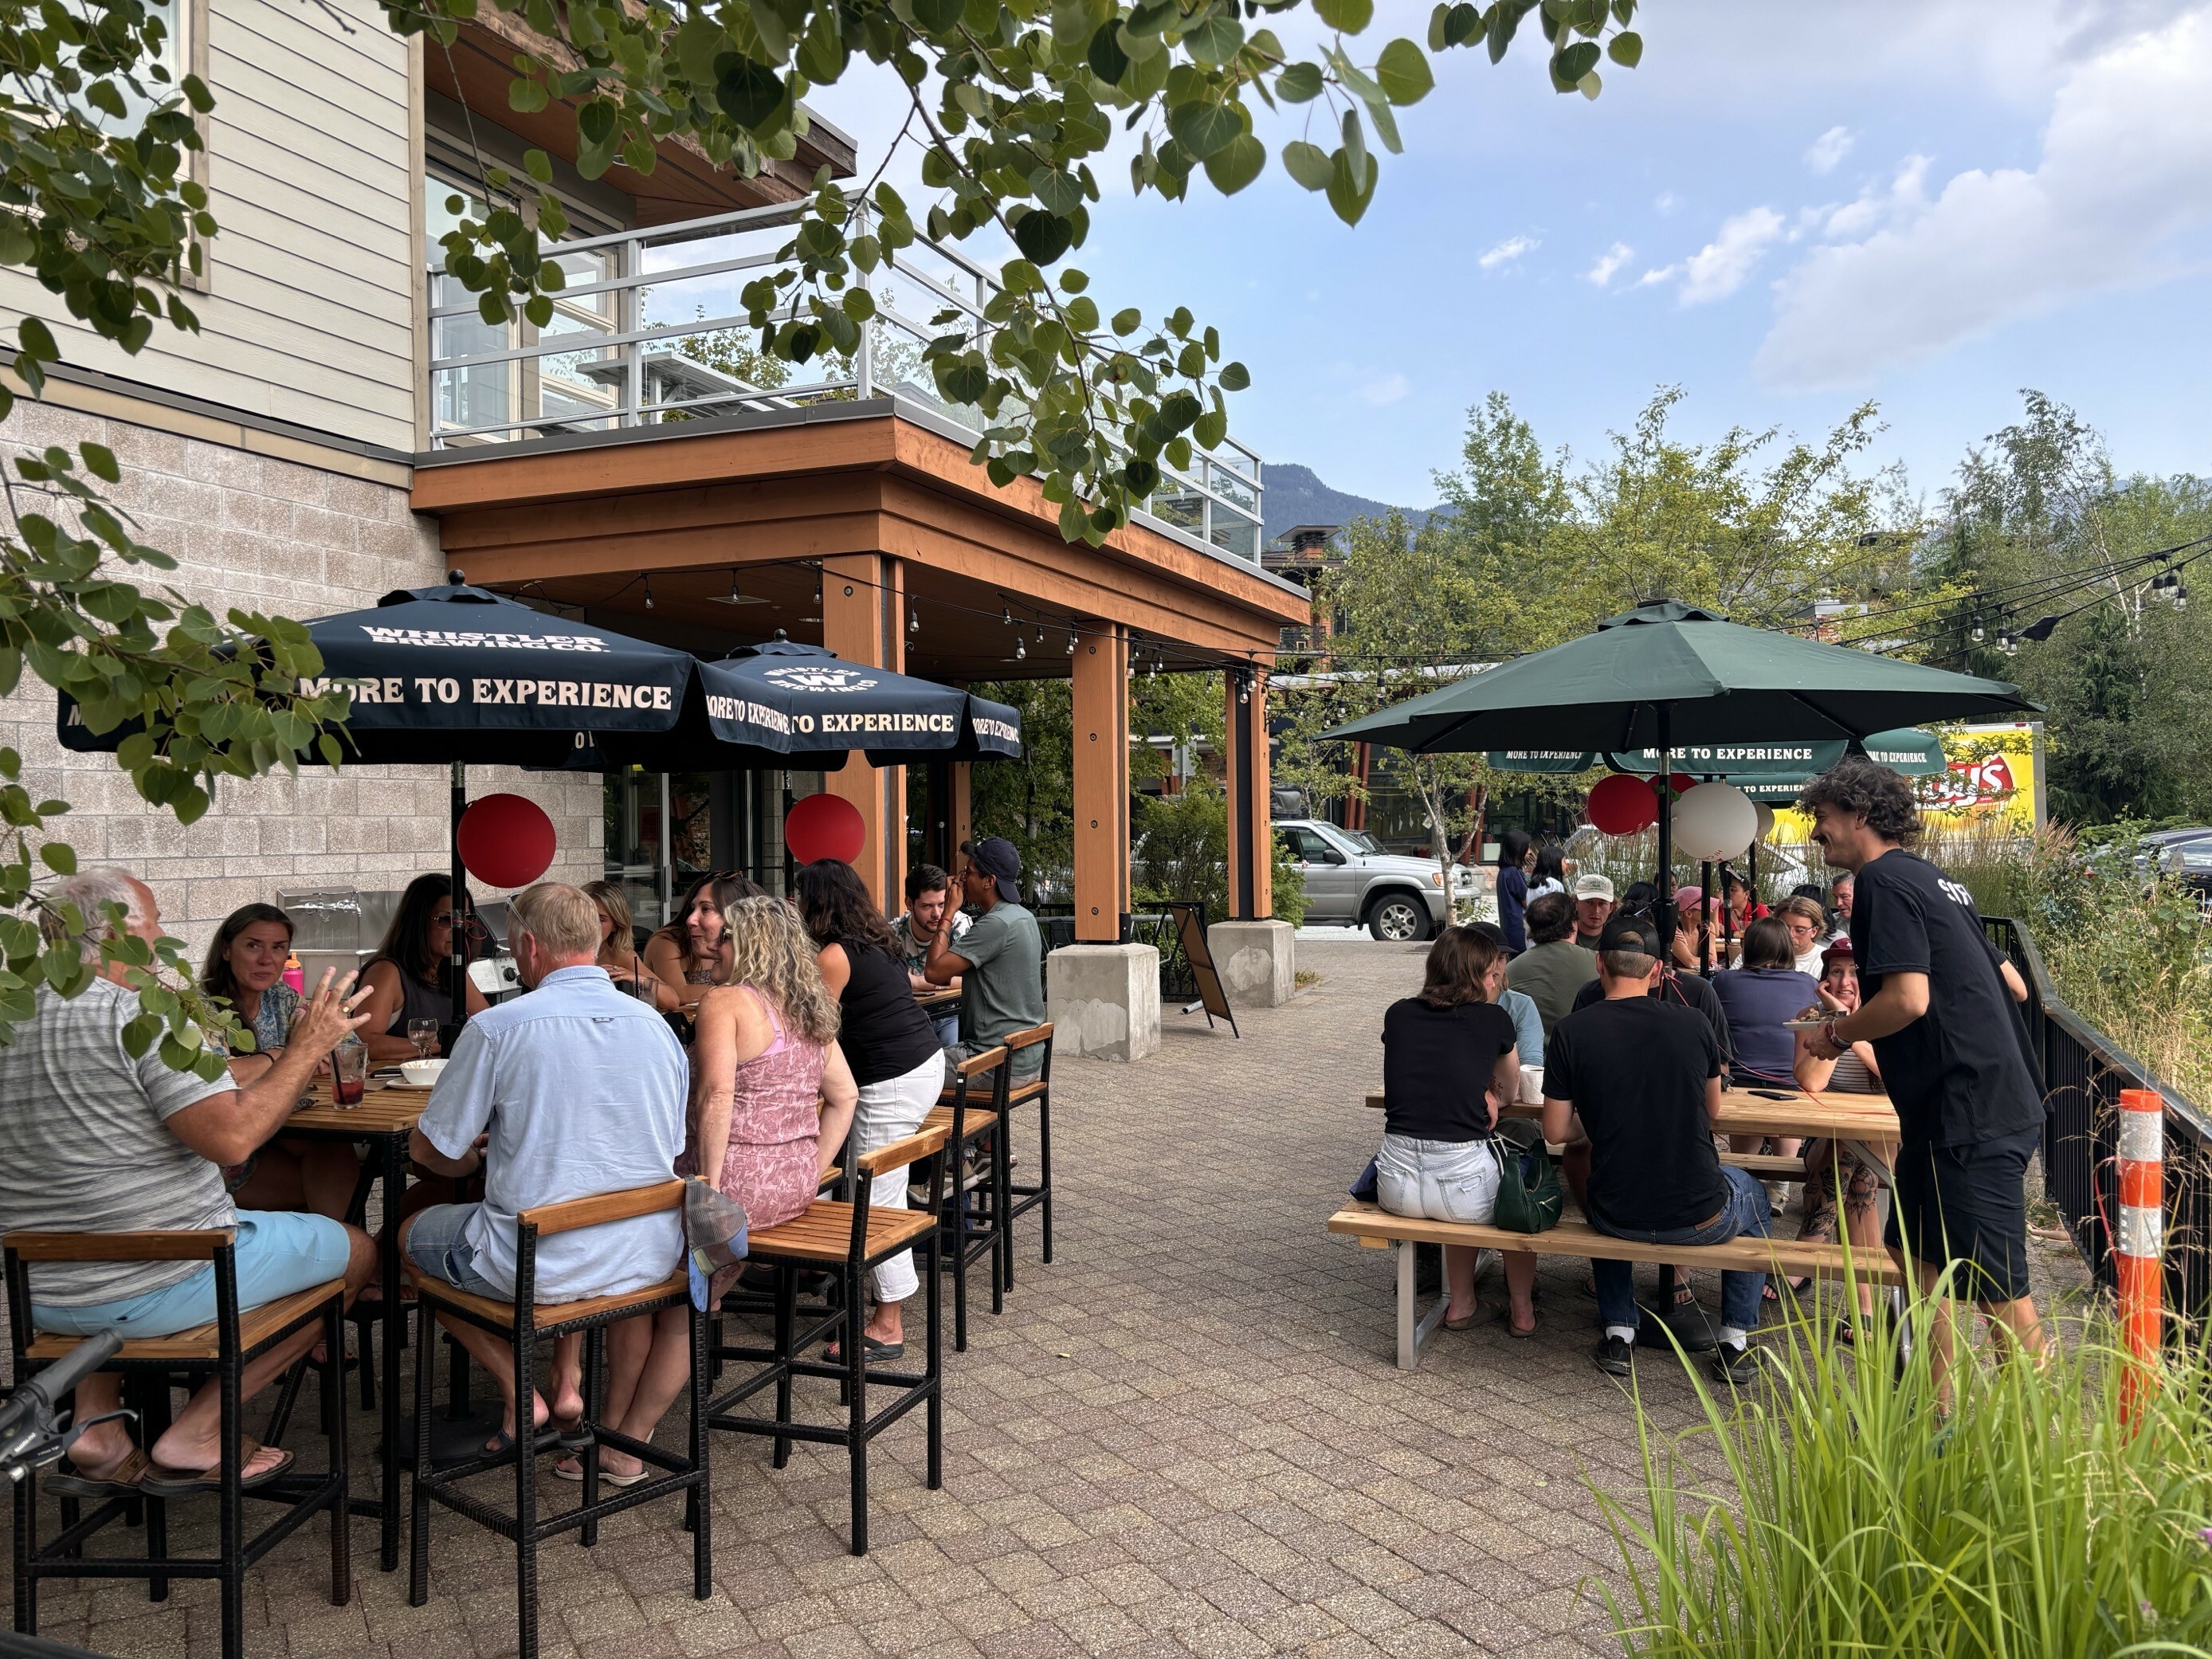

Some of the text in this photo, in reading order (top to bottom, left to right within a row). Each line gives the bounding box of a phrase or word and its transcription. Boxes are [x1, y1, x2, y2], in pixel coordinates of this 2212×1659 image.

[359, 626, 610, 645] WHISTLER
[372, 636, 550, 650] BREWING
[786, 675, 846, 686] W
[414, 678, 461, 703] TO
[473, 678, 672, 711] EXPERIENCE
[822, 714, 954, 732] EXPERIENCE
[1506, 751, 1528, 759] MORE
[1691, 747, 1711, 759] TO
[1716, 748, 1812, 760] EXPERIENCE
[1881, 751, 1888, 763] TO
[1759, 784, 1810, 793] EXPERIEN
